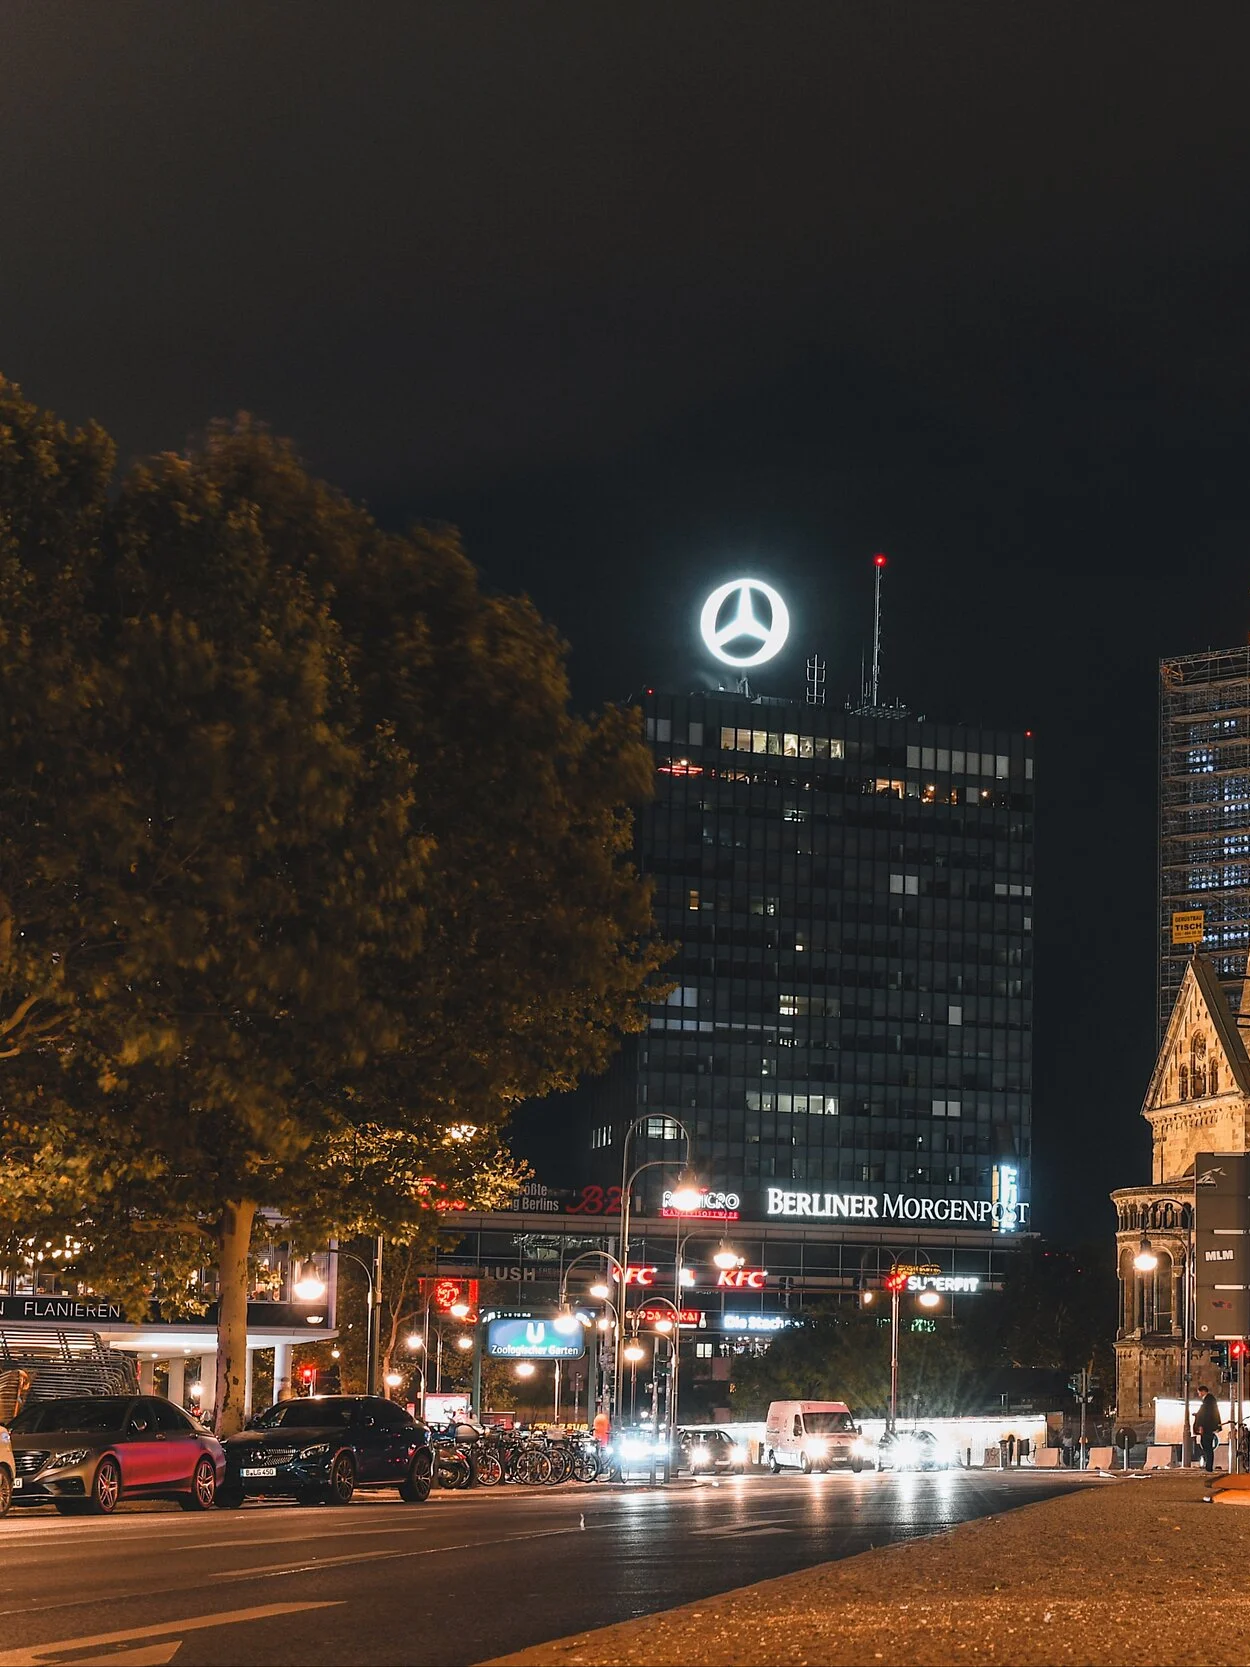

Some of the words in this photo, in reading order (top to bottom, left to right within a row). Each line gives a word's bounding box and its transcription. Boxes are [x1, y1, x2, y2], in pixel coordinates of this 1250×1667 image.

[1176, 923, 1202, 931] TISCH
[522, 1197, 559, 1212] Berlins
[768, 1188, 879, 1218] BERLINER
[1205, 1250, 1234, 1261] MLM
[484, 1266, 536, 1281] LUSH
[717, 1270, 768, 1287] KFC
[24, 1301, 120, 1318] FLANIEREN
[526, 1322, 545, 1344] U
[491, 1345, 547, 1356] Zoologischer
[548, 1345, 579, 1355] Garten
